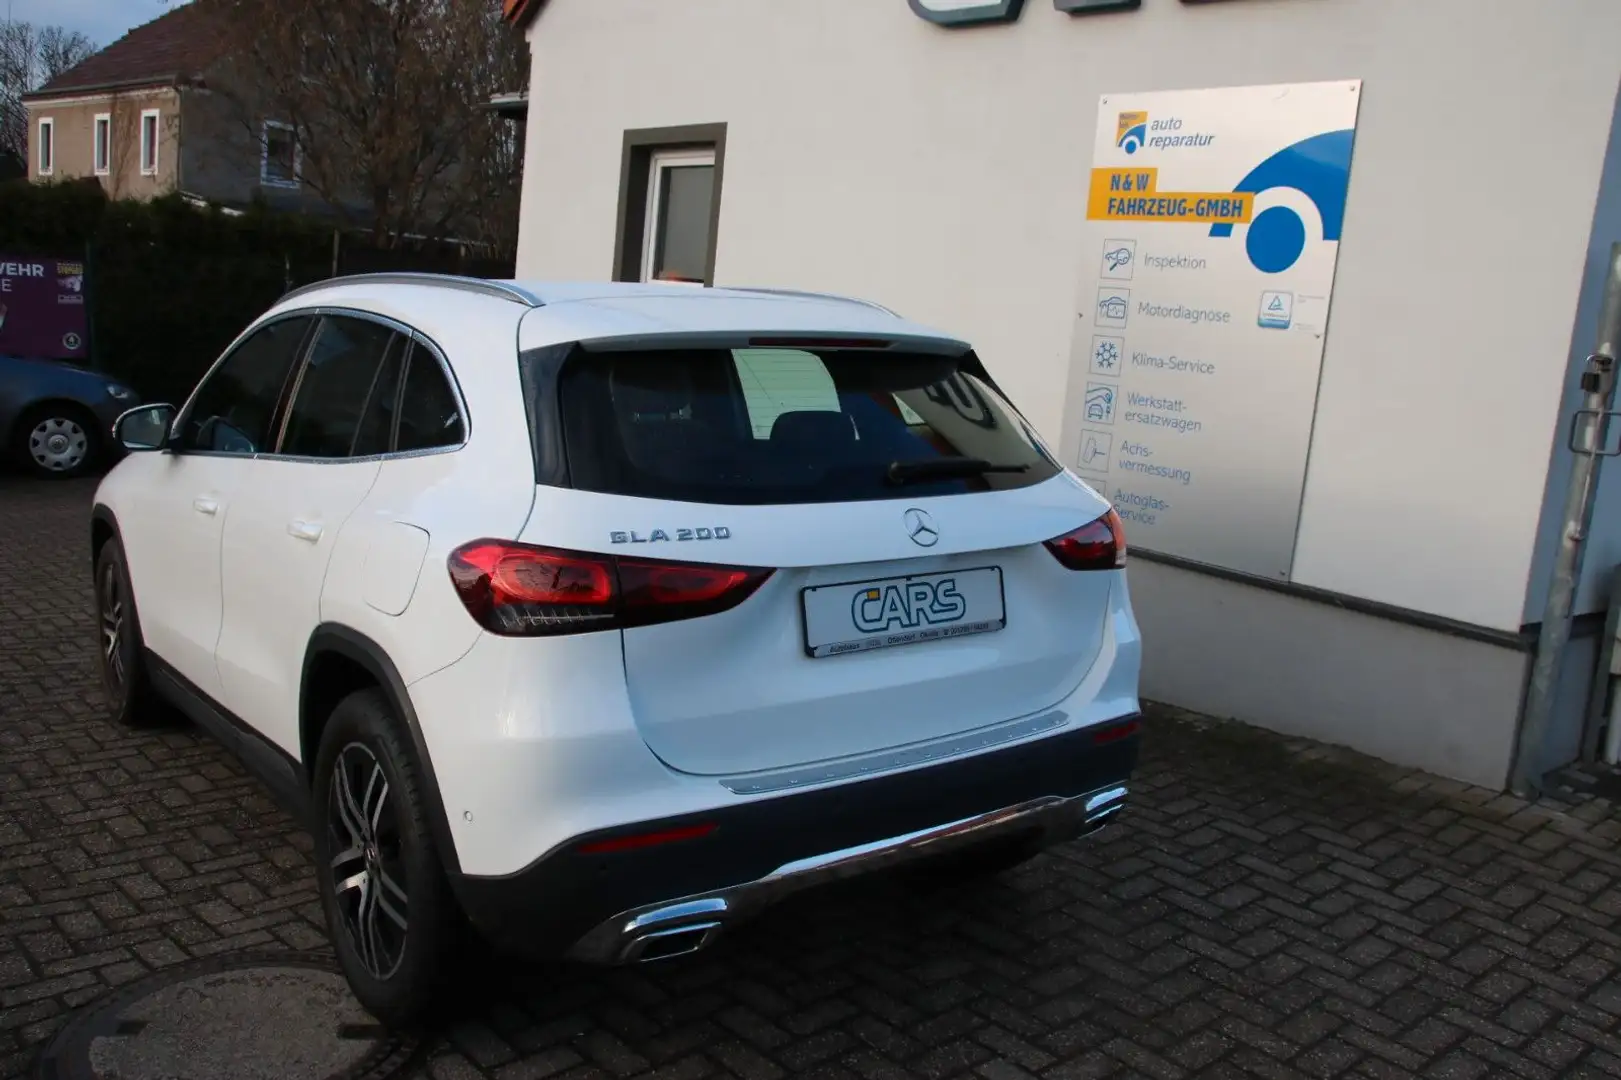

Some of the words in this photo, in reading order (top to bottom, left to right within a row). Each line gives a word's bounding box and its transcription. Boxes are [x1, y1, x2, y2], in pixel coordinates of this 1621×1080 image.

[1151, 116, 1182, 131] auto
[1148, 133, 1215, 150] reparatur
[1110, 174, 1120, 191] N
[1123, 174, 1133, 190] &
[1136, 174, 1149, 190] W
[1107, 197, 1243, 218] FAHRZEUG-GMBH
[1144, 254, 1206, 271] Inspektion
[1137, 302, 1231, 324] Motordiagnose
[1131, 352, 1216, 374] Klima-Service
[1127, 392, 1187, 412] Werkstatt-
[1124, 411, 1202, 433] ersatzwagen
[1120, 441, 1154, 457] Achs-
[1118, 459, 1191, 484] vermessung
[1114, 490, 1170, 511] Autoglas-
[610, 529, 670, 544] GLA
[675, 526, 731, 541] 200
[852, 578, 966, 633] CARS
